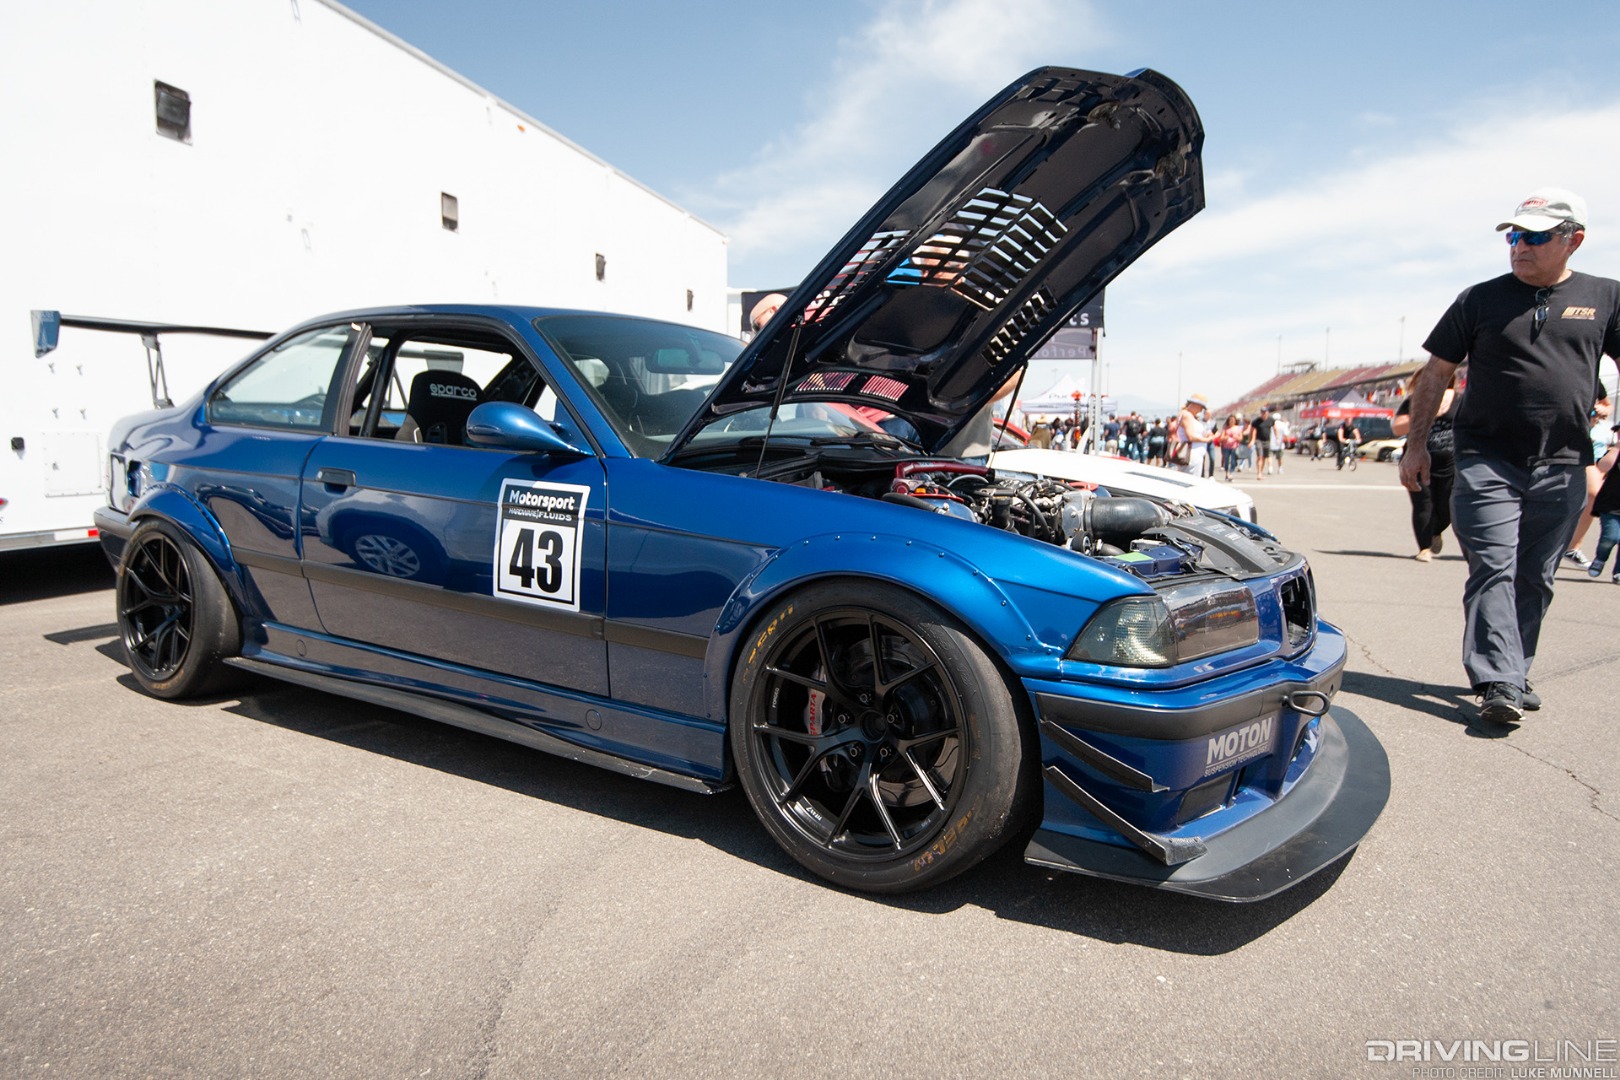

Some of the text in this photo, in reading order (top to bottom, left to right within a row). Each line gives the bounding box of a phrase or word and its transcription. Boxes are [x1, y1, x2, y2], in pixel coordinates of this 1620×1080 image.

[430, 383, 477, 398] sparco
[509, 489, 575, 512] Motorsport
[538, 511, 572, 522] FLUIDS
[509, 528, 564, 594] 43
[1207, 717, 1272, 764] MOTON
